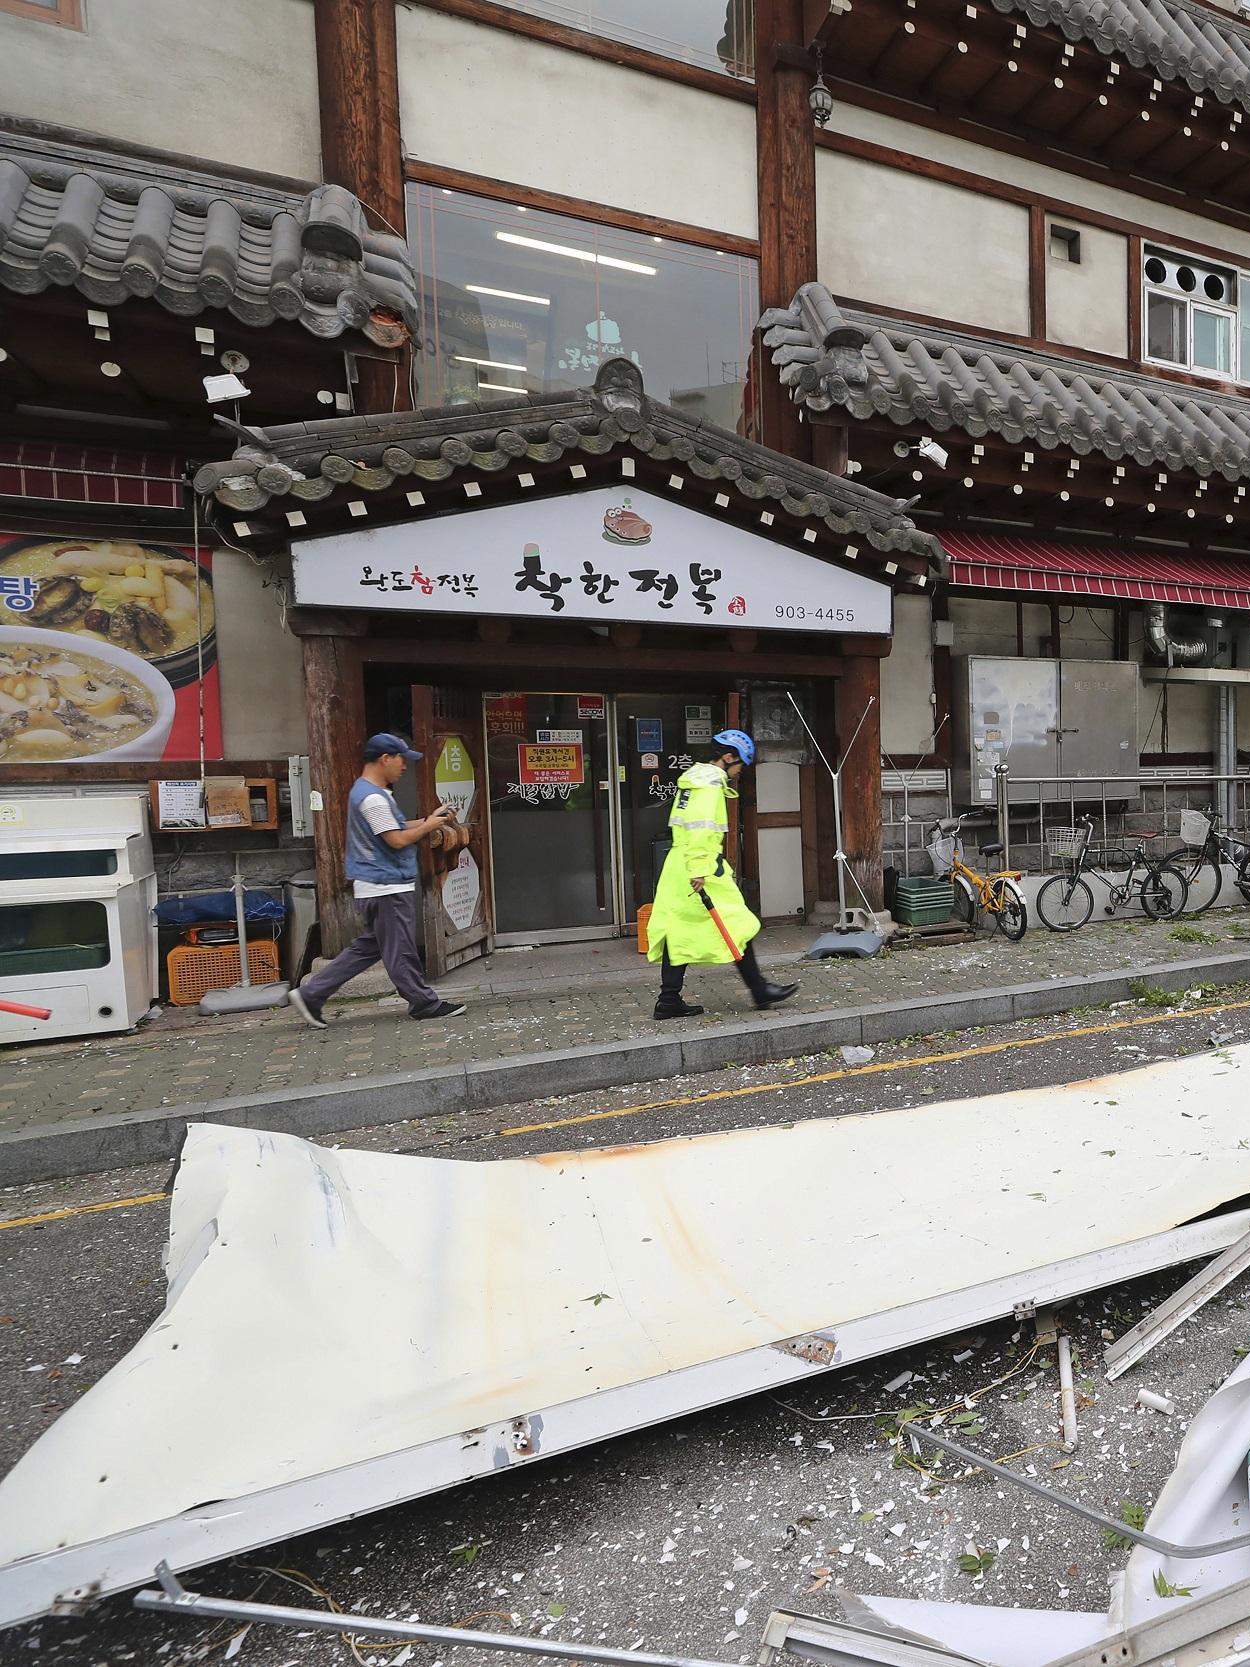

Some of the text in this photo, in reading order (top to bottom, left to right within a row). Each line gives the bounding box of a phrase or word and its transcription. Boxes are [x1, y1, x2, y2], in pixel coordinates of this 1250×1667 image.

[0, 576, 39, 612] 탕
[775, 605, 855, 622] 903-4455
[443, 745, 462, 772] 1층
[528, 755, 543, 763] 오후
[668, 754, 694, 770] 2층
